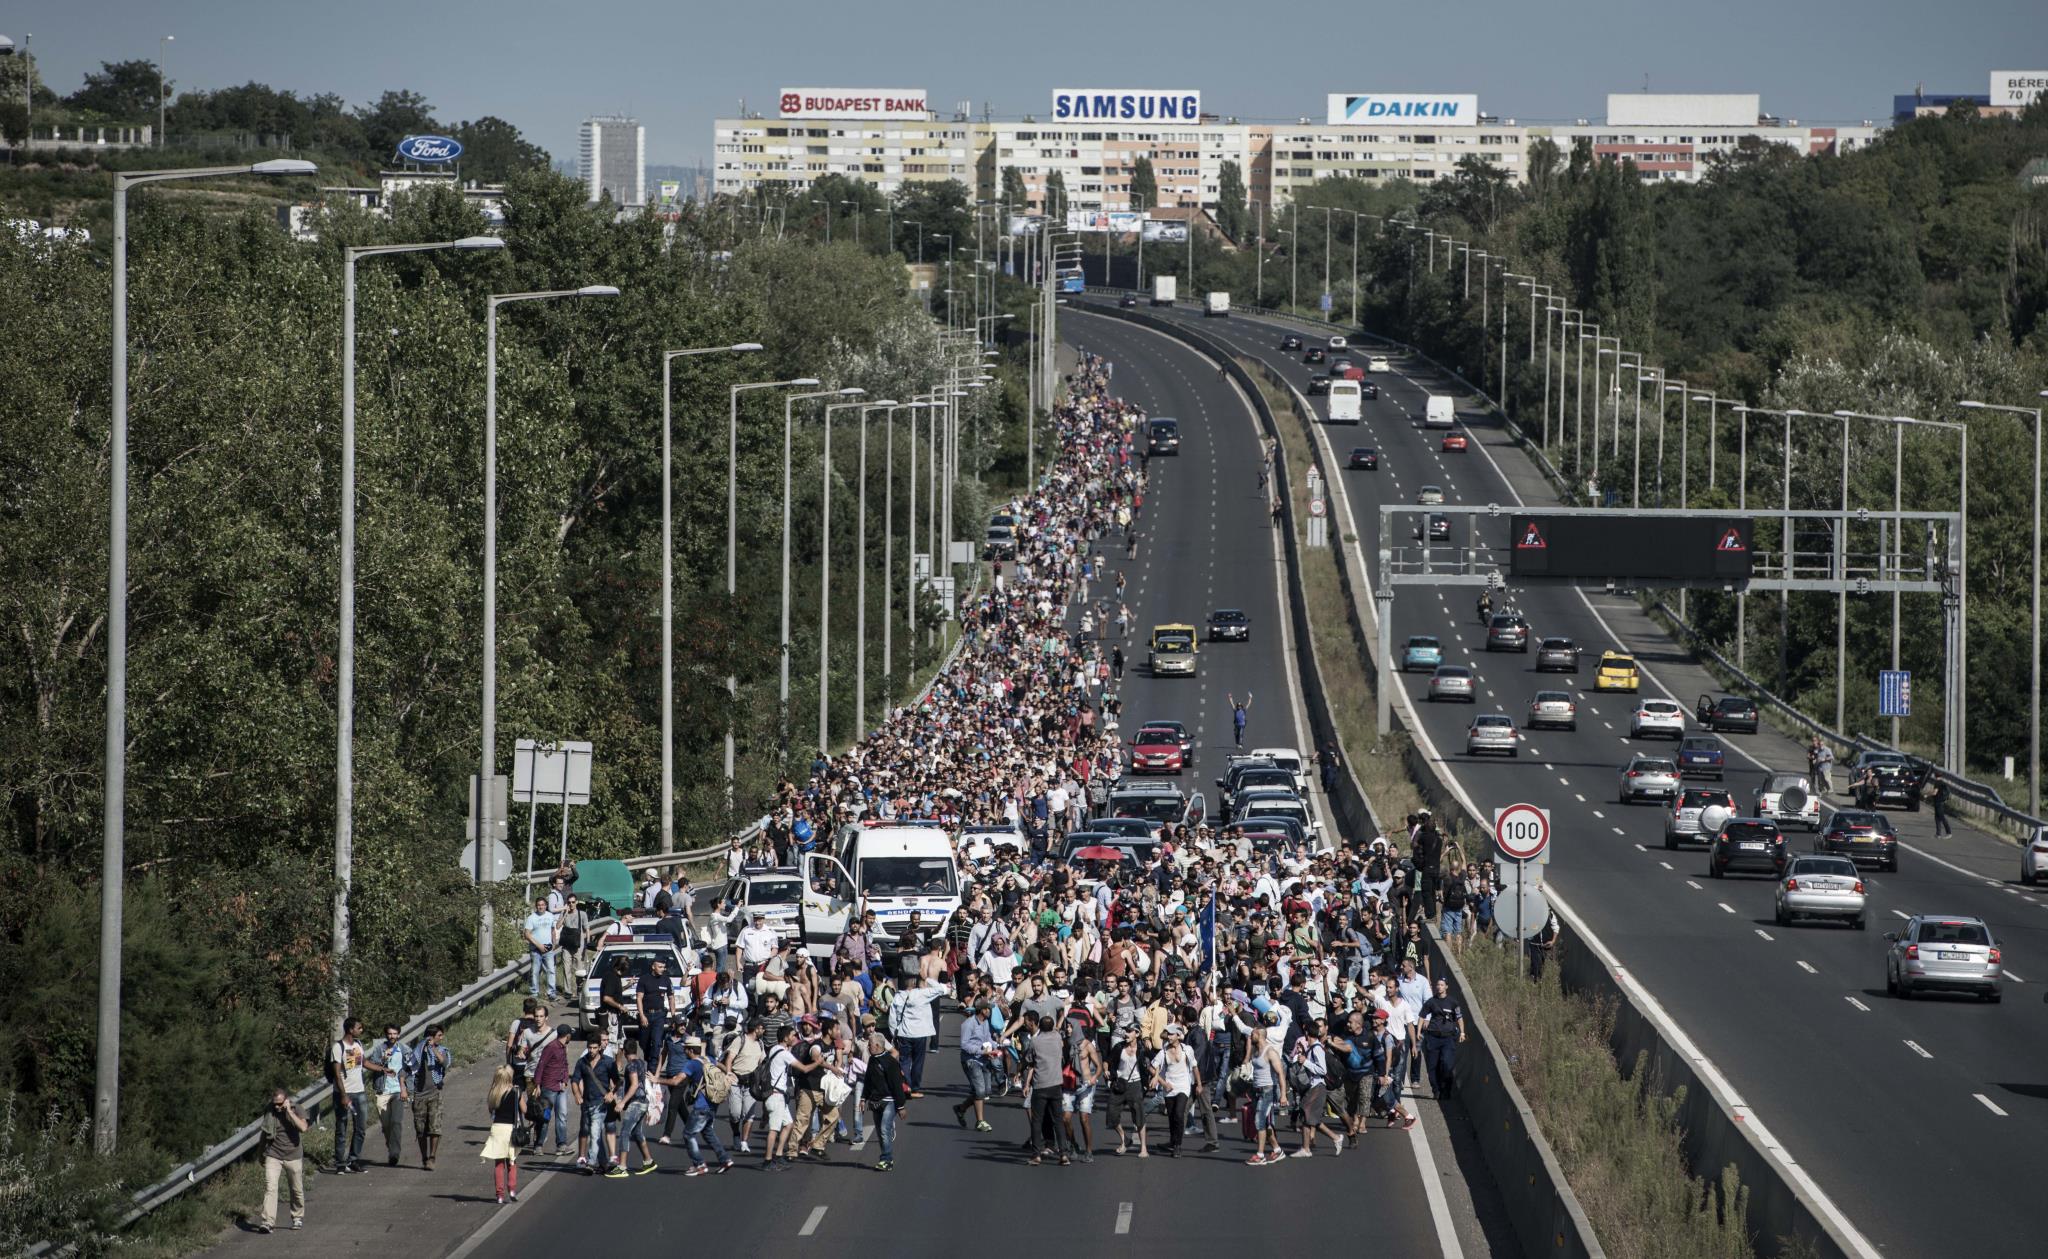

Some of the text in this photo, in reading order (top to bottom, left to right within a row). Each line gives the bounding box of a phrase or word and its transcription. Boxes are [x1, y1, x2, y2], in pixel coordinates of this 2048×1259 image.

[2008, 90, 2023, 100] 70
[805, 97, 925, 112] BUDAPEST BANK
[1056, 95, 1197, 119] SAMSUNG
[1367, 102, 1459, 117] DAIKIN
[411, 139, 451, 157] Ford
[1506, 821, 1539, 840] 100
